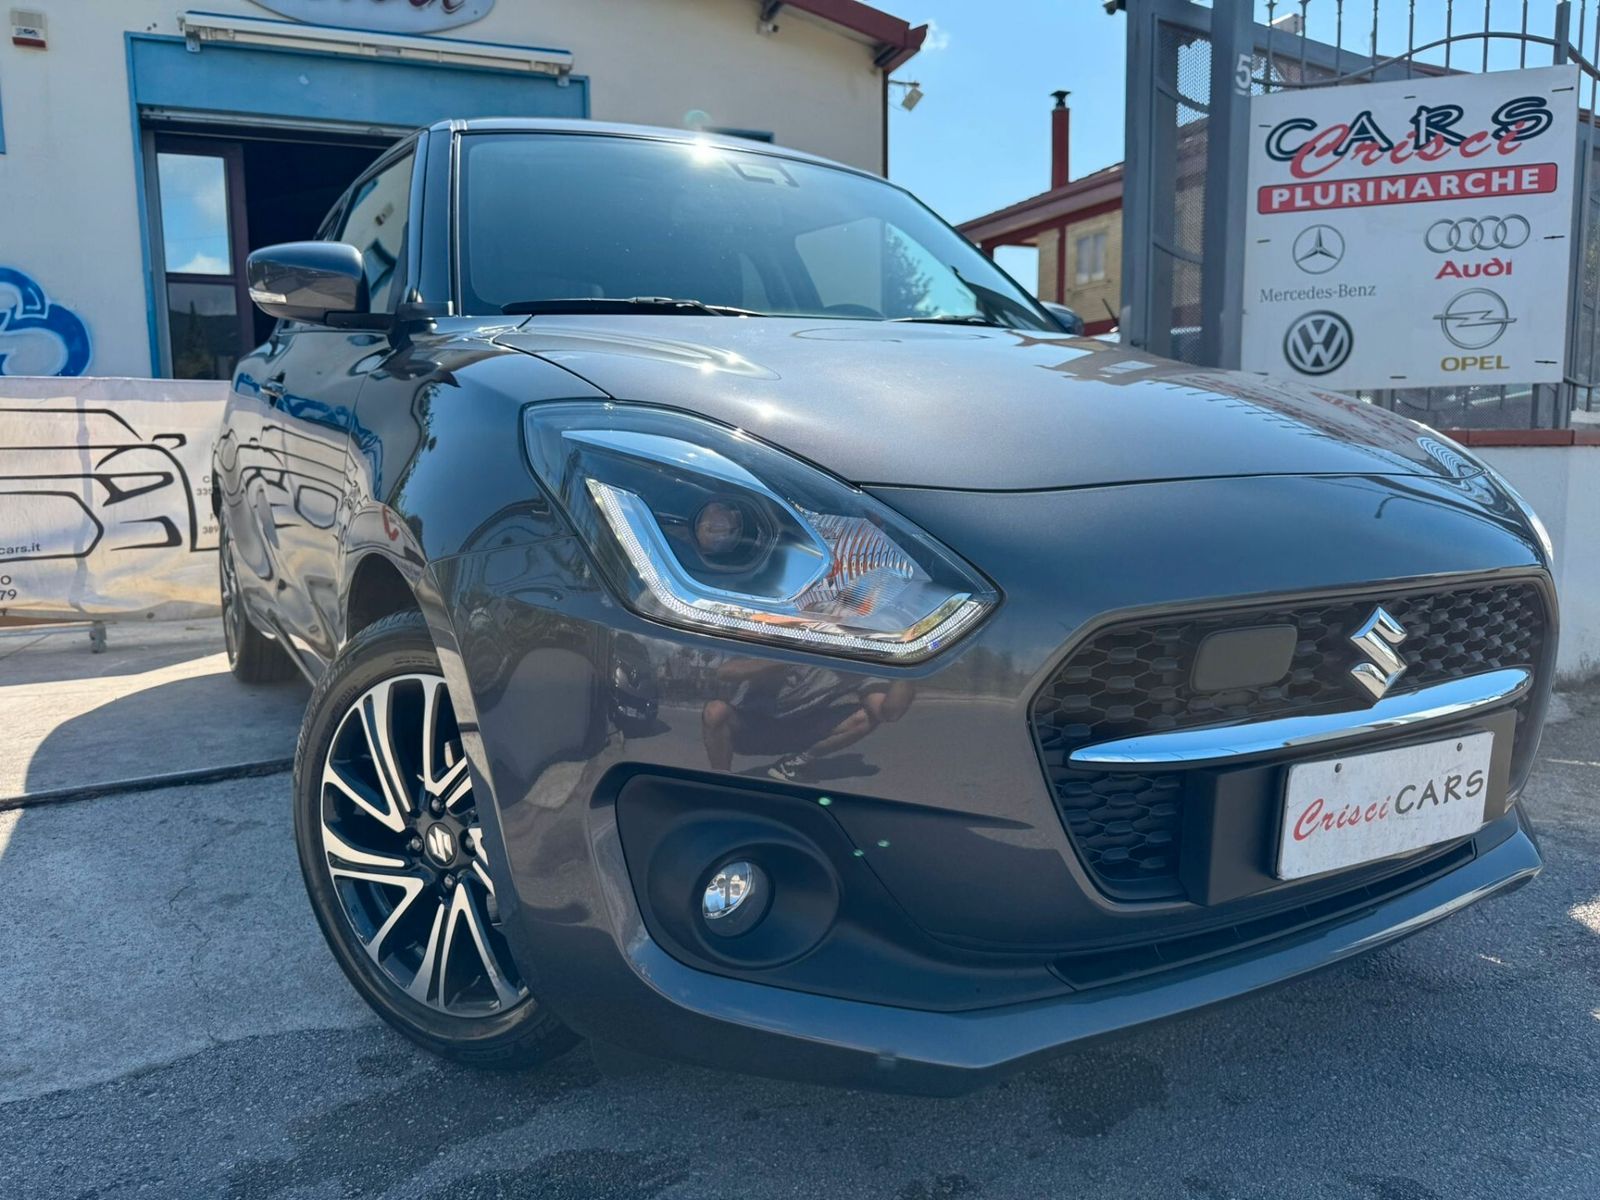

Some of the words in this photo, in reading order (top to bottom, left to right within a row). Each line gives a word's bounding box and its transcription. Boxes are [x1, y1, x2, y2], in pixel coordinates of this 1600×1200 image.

[1236, 53, 1251, 89] 5
[1265, 96, 1553, 162] CARS
[1290, 120, 1523, 179] Crisci
[1271, 168, 1540, 209] PLURIMARCHE
[1435, 258, 1513, 279] Audi
[1259, 283, 1377, 303] Mercedes-Benz
[1440, 355, 1510, 371] OPEL
